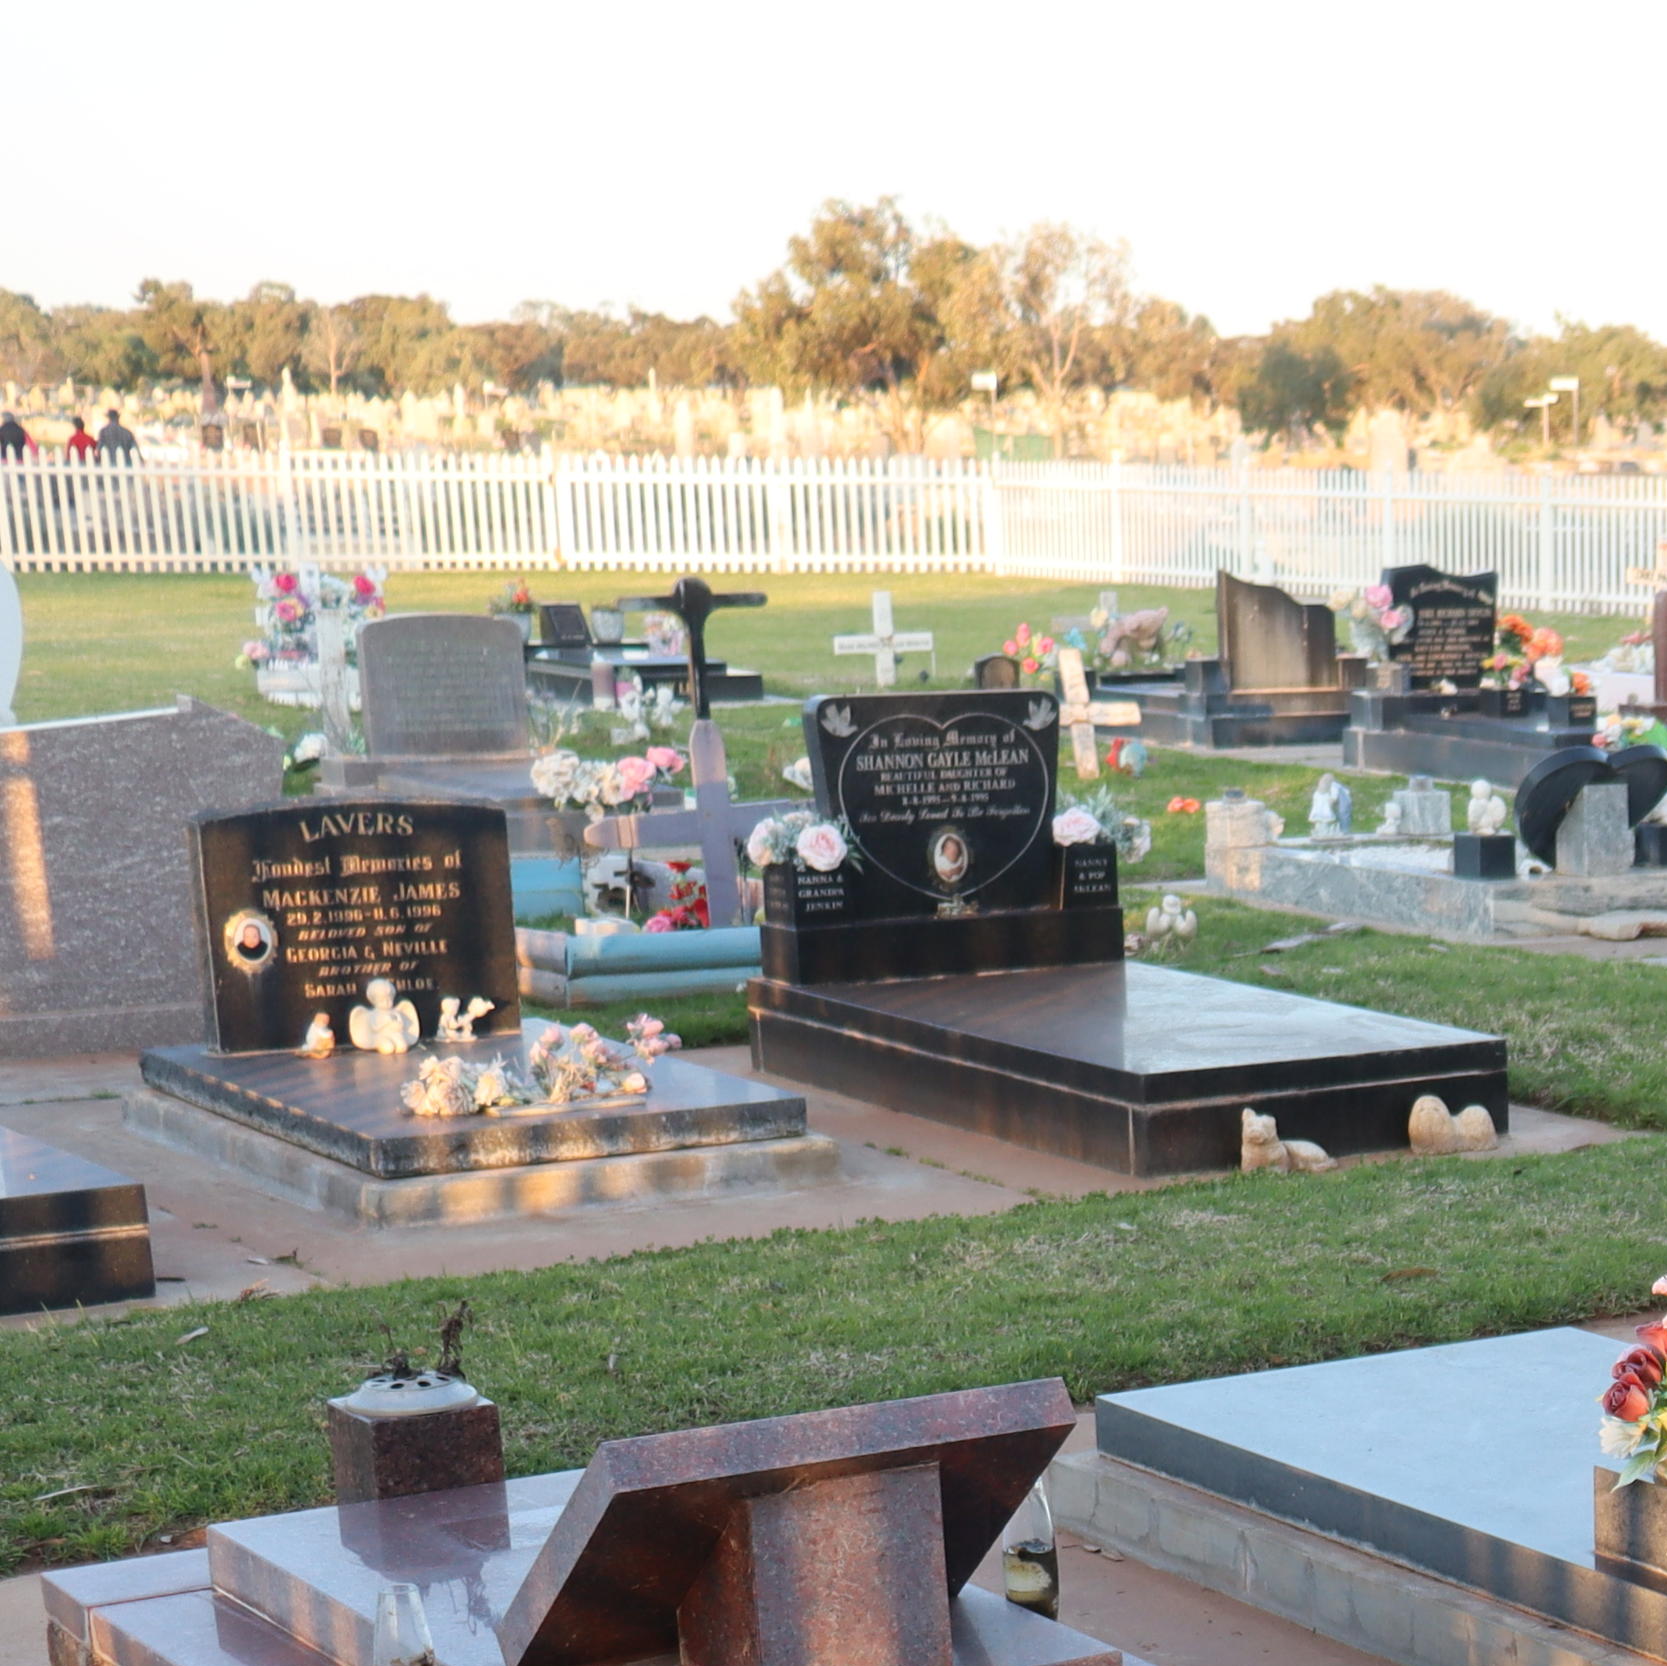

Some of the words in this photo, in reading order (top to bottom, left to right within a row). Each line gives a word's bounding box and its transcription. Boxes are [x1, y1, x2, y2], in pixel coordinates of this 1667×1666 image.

[869, 733, 888, 750] In
[894, 732, 940, 750] Loving
[943, 729, 997, 749] Memory
[1003, 728, 1016, 743] of
[856, 753, 923, 772] SHANNON
[927, 751, 971, 768] GAYLE
[880, 770, 936, 782] BEAUTIFUL
[940, 769, 992, 779] DAUGHTER
[995, 767, 1008, 777] OF
[874, 782, 934, 796] MICHELLE
[938, 782, 961, 792] AND
[963, 779, 1016, 791] RICHARD
[300, 812, 414, 843] LAVERS
[340, 854, 433, 878] Memories
[443, 850, 462, 869] of
[262, 885, 381, 911] MACKENZIE
[393, 881, 461, 901] JAMES
[298, 926, 366, 941] BELOVED
[374, 924, 406, 937] SON
[414, 922, 434, 934] OF
[286, 945, 358, 964] GEORGIA
[382, 939, 448, 958] NEVILLE
[318, 962, 392, 978] BROTHER
[400, 960, 418, 972] OF
[305, 982, 357, 999] SARAH
